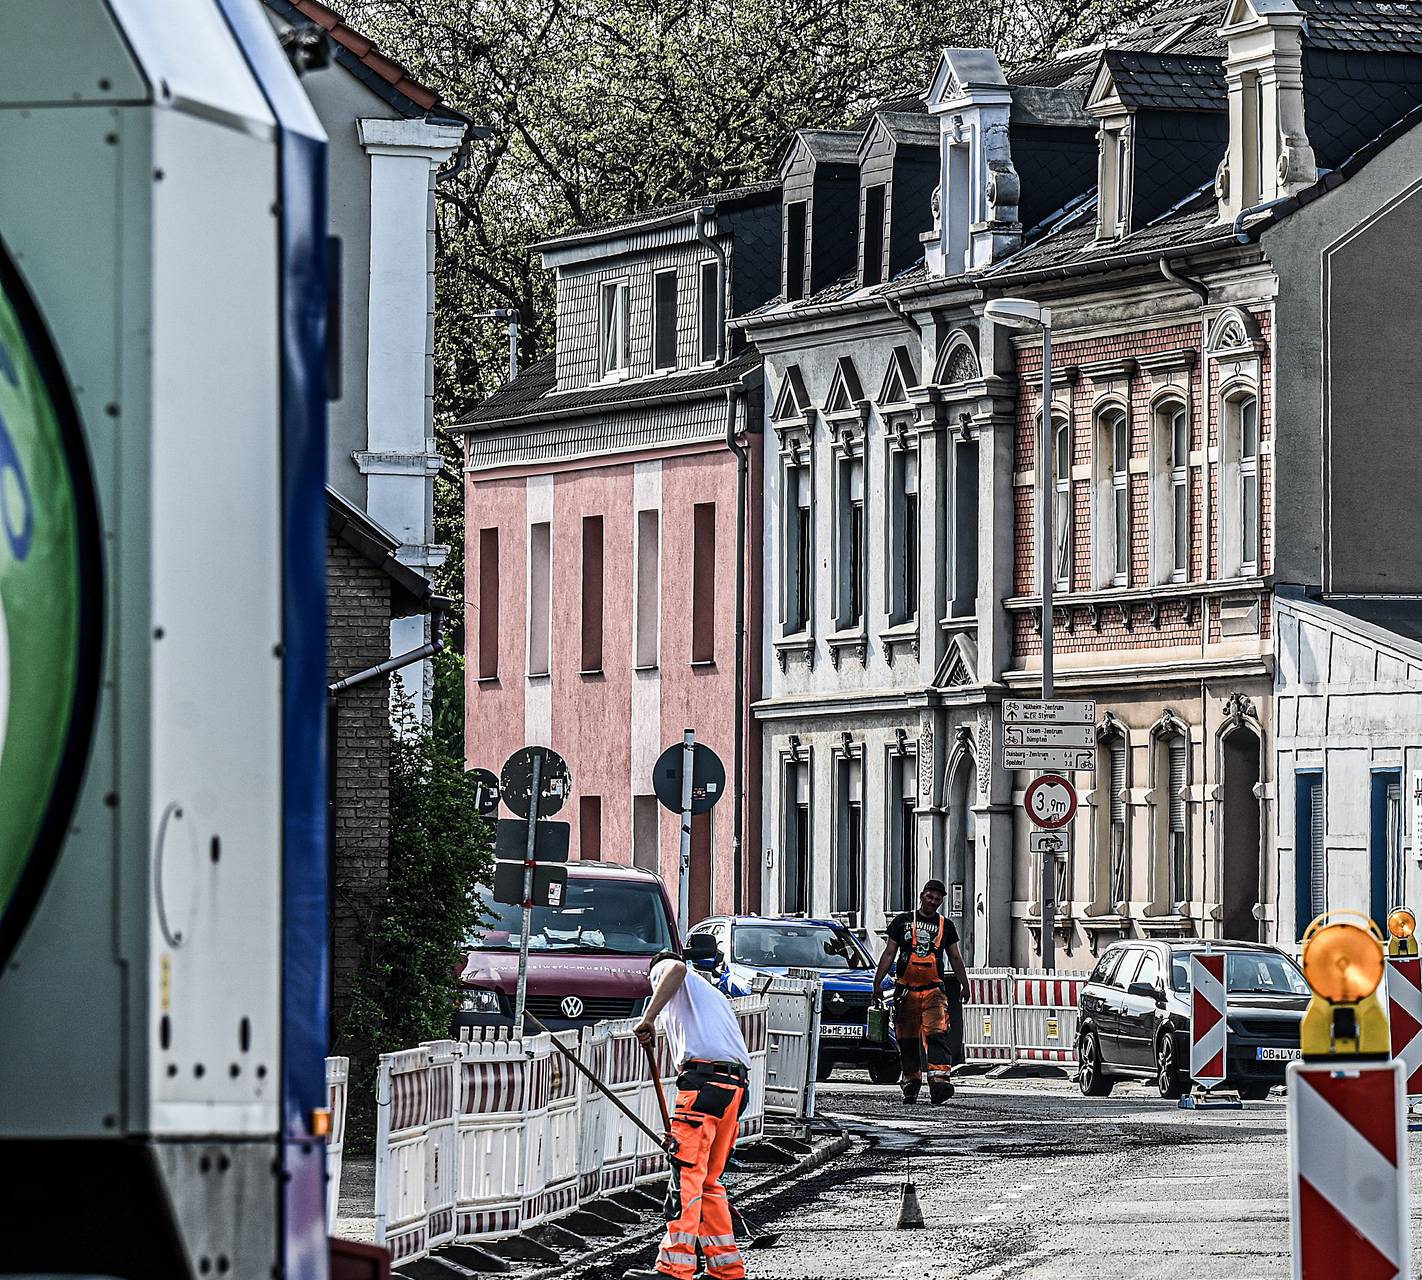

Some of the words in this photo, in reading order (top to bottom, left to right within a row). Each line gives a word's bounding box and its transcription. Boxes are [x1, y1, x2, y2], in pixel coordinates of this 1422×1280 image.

[1038, 712, 1056, 720] Styrum
[1006, 759, 1026, 767] Speldorf
[1036, 791, 1067, 813] 3,9m
[1263, 1049, 1275, 1059] OB
[1280, 1049, 1294, 1060] LY
